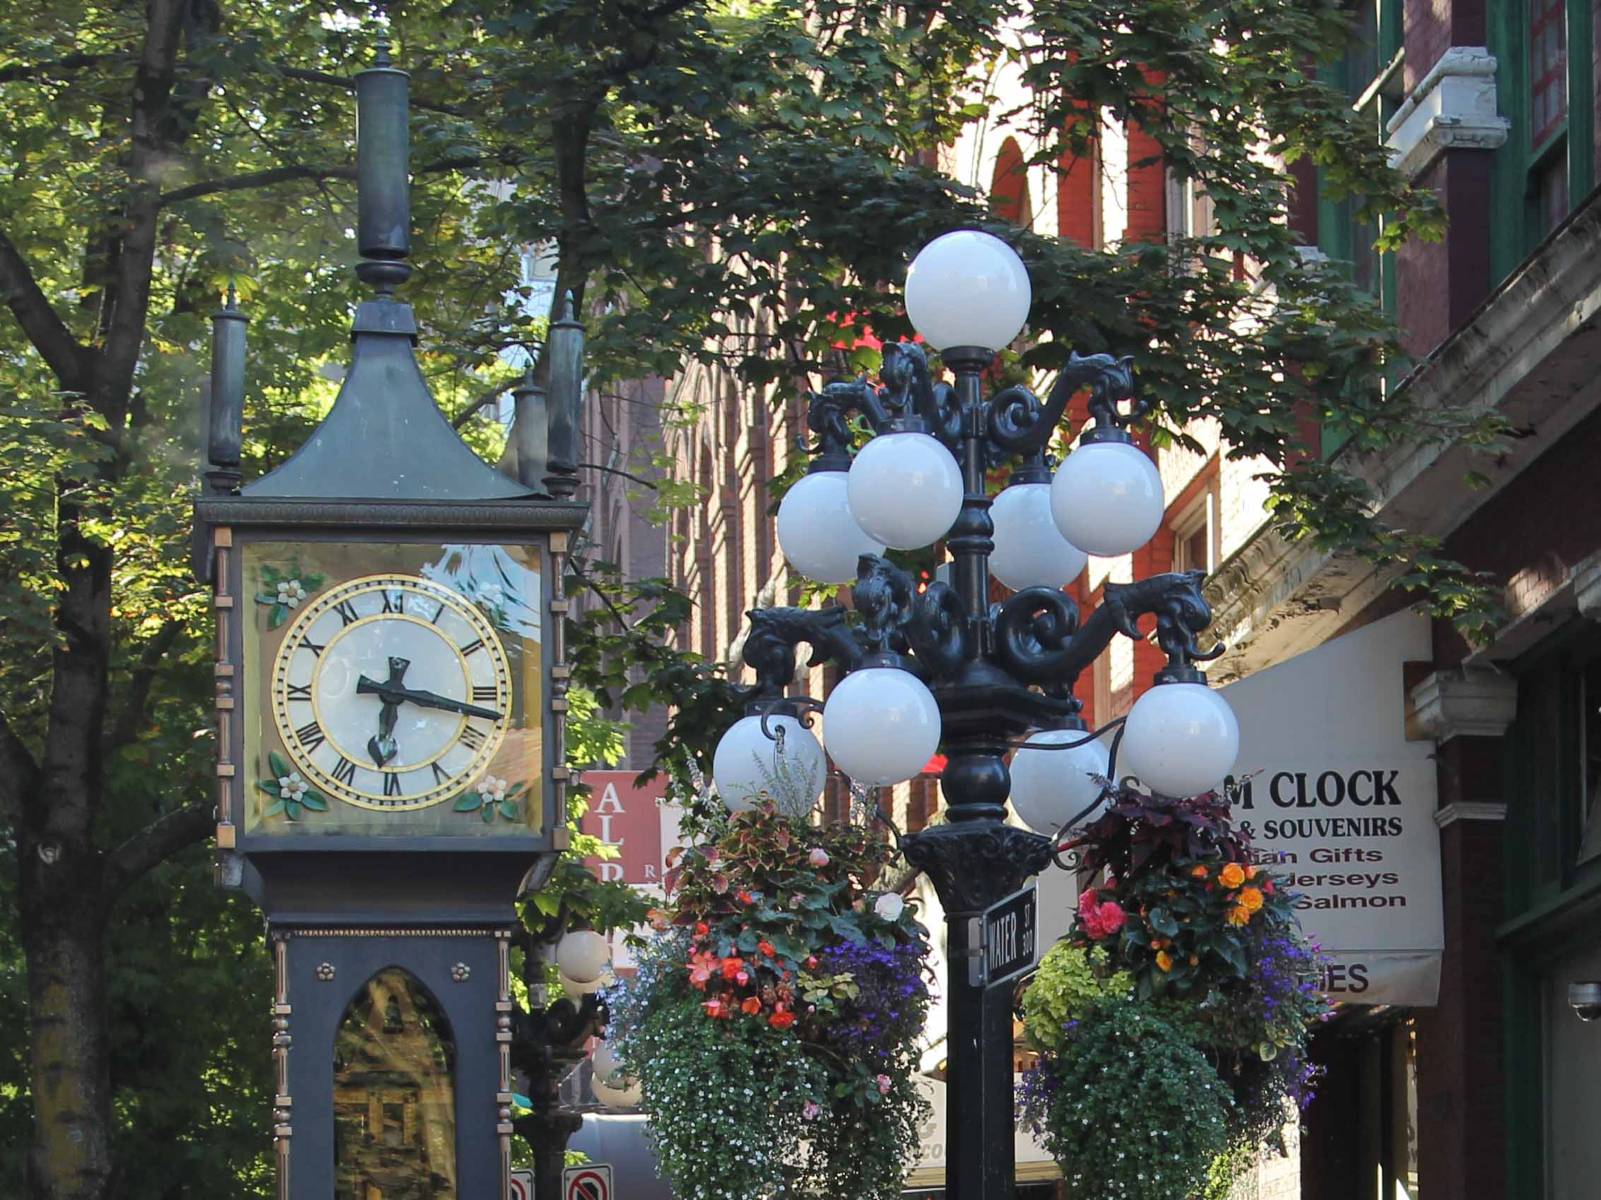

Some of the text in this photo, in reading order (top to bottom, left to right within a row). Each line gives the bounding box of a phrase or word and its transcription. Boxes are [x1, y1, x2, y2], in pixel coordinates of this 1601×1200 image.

[333, 599, 360, 627] XI
[299, 636, 326, 658] X
[461, 639, 485, 657] II
[287, 684, 312, 701] IX
[473, 686, 497, 700] III
[296, 721, 326, 754] VIII
[331, 756, 356, 787] VII
[1269, 769, 1402, 809] CLOCK
[1264, 816, 1403, 841] SOUVENIRS
[1309, 847, 1384, 864] Gifts
[1287, 871, 1399, 889] Jerseys
[1295, 894, 1407, 910] Salmon
[989, 911, 1017, 970] WATER
